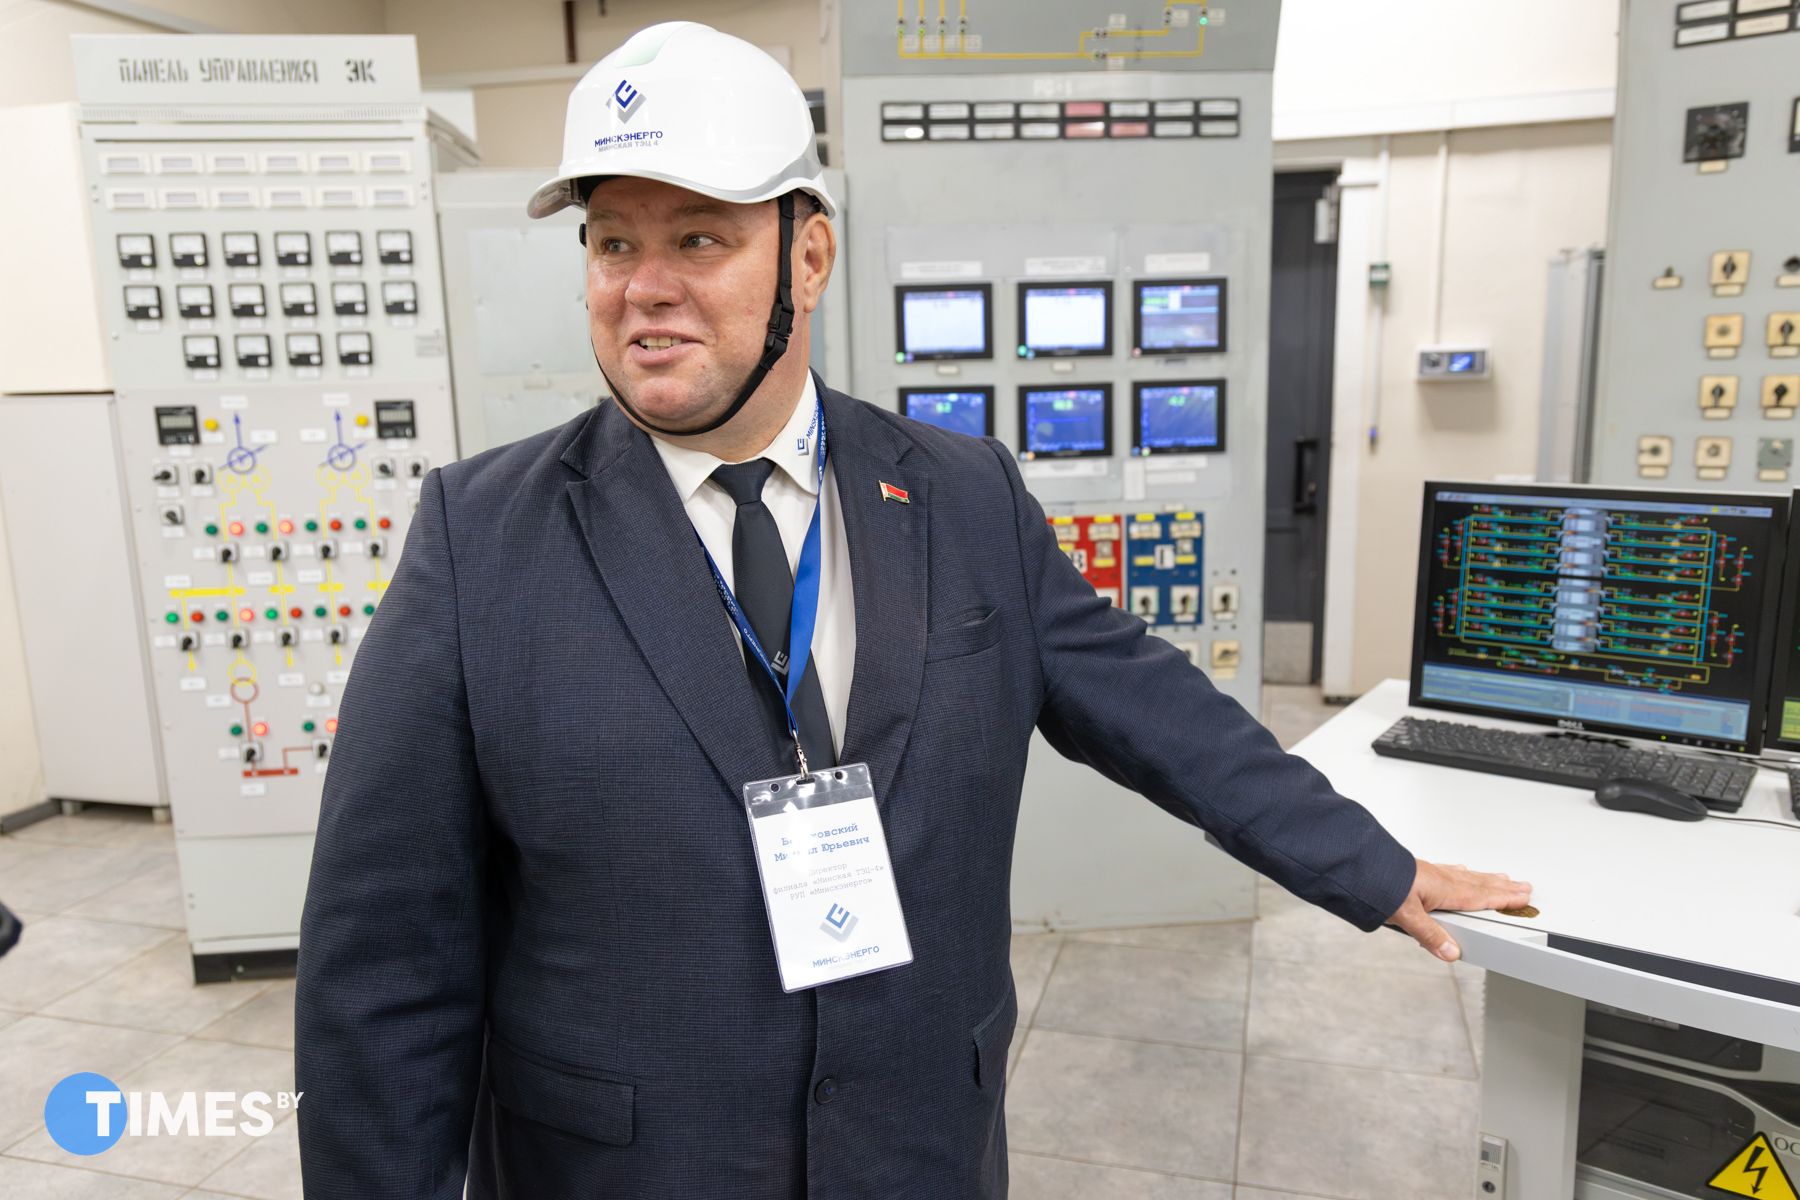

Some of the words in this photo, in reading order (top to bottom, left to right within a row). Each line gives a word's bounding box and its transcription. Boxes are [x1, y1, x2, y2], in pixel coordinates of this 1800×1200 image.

[118, 58, 189, 83] ПАНЕЛЬ
[199, 58, 320, 83] УПРАВЛЕНИЯ
[344, 58, 377, 83] ЭК
[594, 131, 663, 147] МИНСКЭНЕРГО
[598, 141, 633, 152] МИНСКАЯ
[821, 836, 870, 852] Юрьевич
